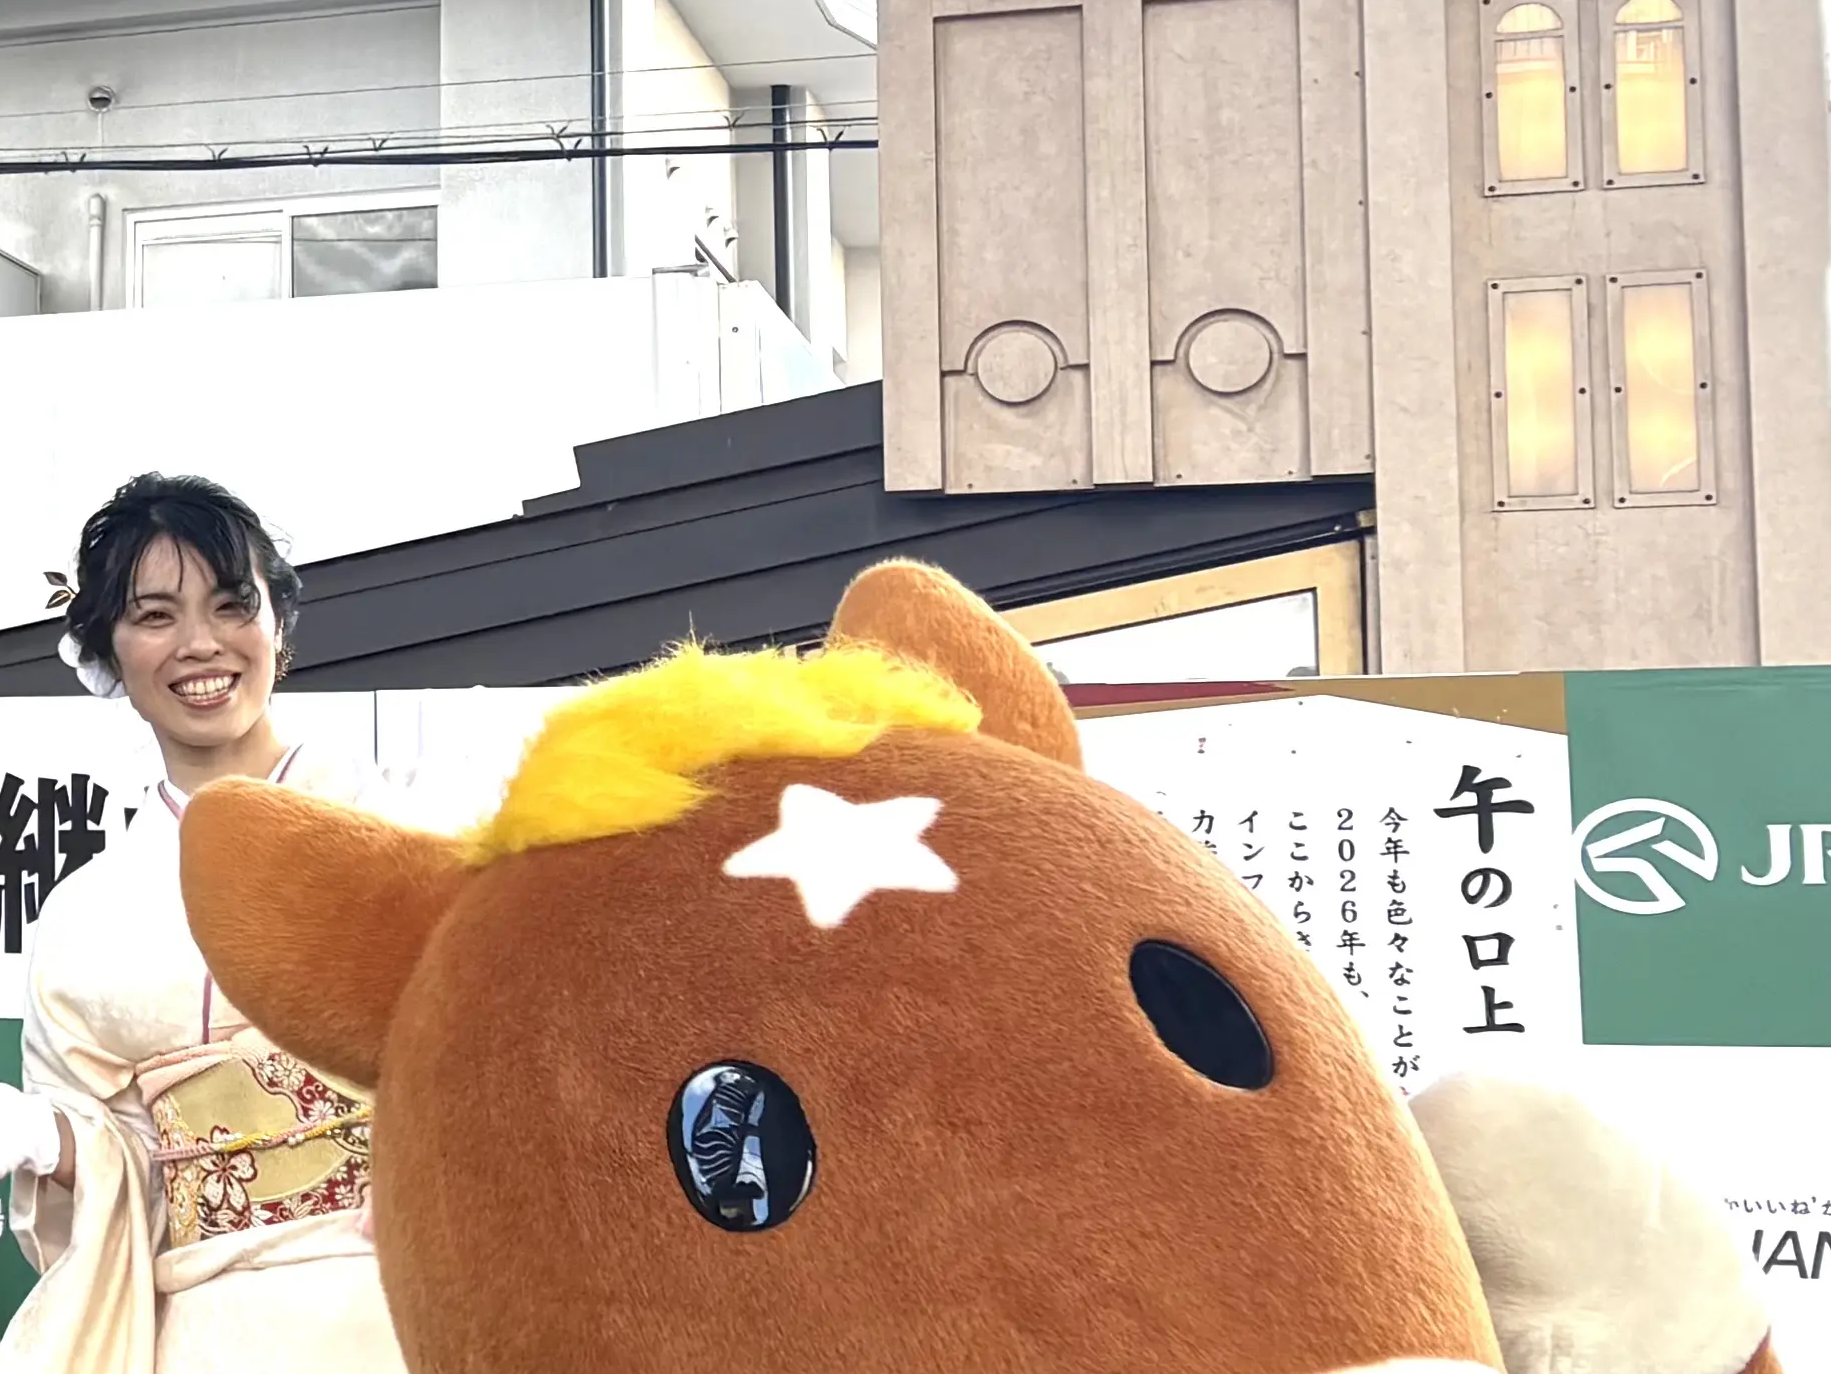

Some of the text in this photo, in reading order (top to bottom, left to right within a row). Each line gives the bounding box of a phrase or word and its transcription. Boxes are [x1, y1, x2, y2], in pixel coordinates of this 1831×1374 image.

[1335, 808, 1370, 999] 2026年も、
[1379, 807, 1420, 1096] 今年も色々なことが
[1433, 764, 1535, 1036] 午の口上
[1740, 823, 1831, 887] JR
